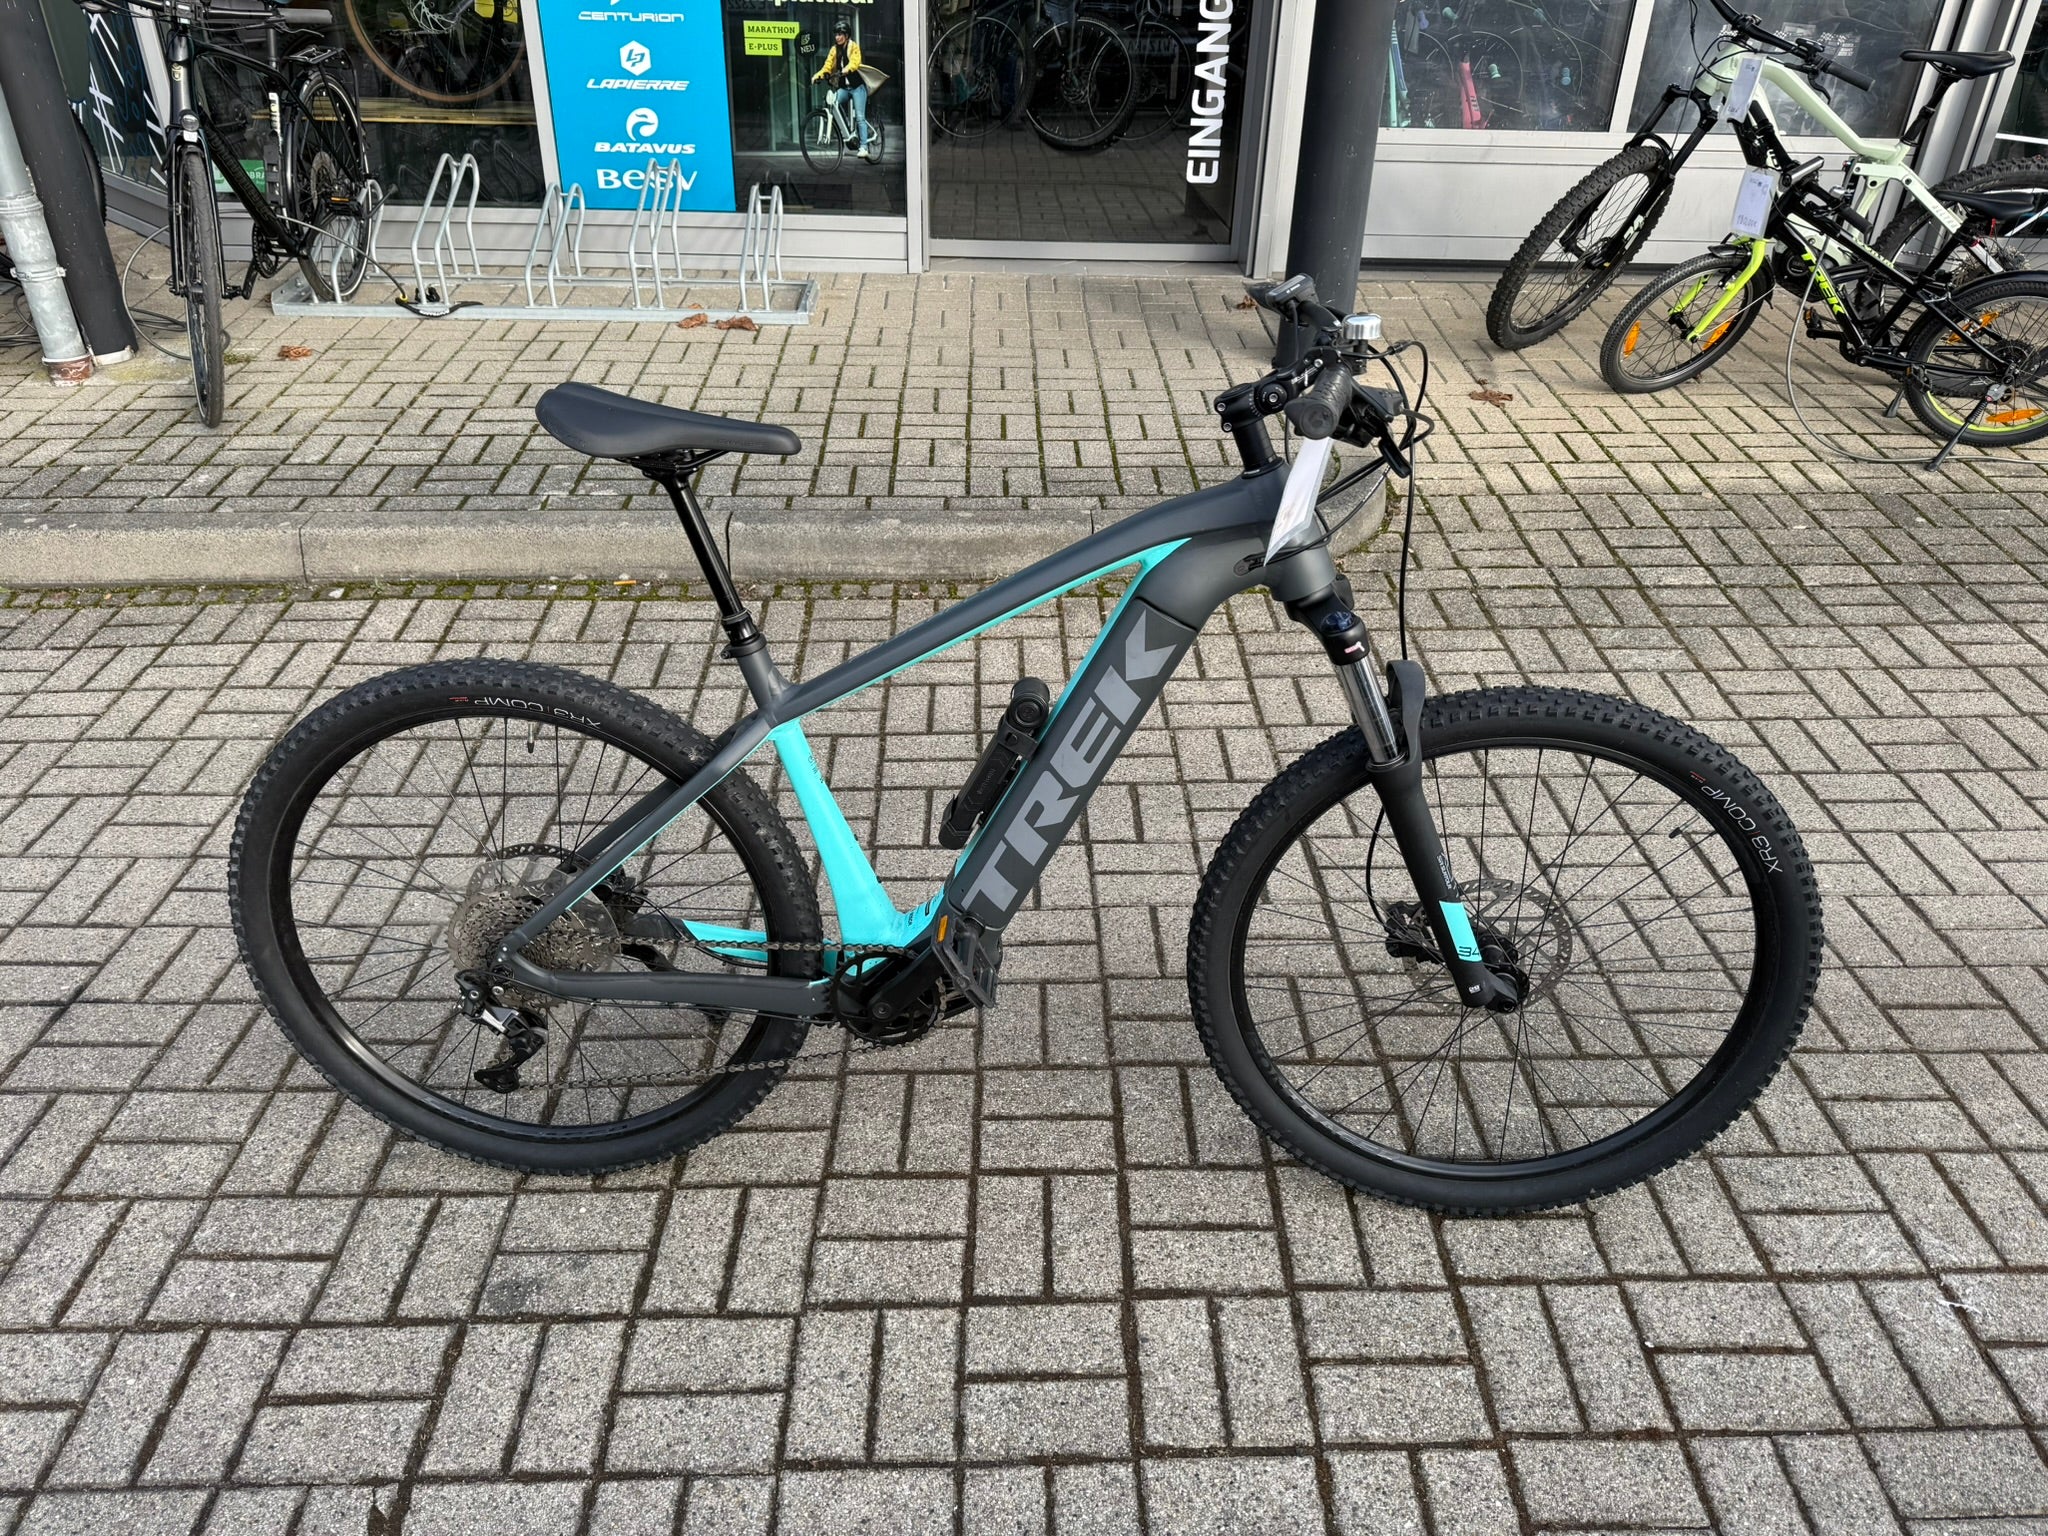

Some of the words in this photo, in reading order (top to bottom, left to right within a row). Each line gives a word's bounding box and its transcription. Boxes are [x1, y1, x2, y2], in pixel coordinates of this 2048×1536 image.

[747, 25, 796, 35] MARATHON
[748, 42, 779, 52] E-PLUS
[586, 78, 691, 92] LAPIERRE
[1186, 0, 1233, 184] EINGANG
[594, 142, 697, 155] BATAVUS
[1801, 251, 1846, 316] TREK
[474, 696, 544, 712] COMP
[961, 608, 1178, 912] TREK
[1701, 785, 1757, 831] COMP
[1751, 835, 1783, 873] XR3
